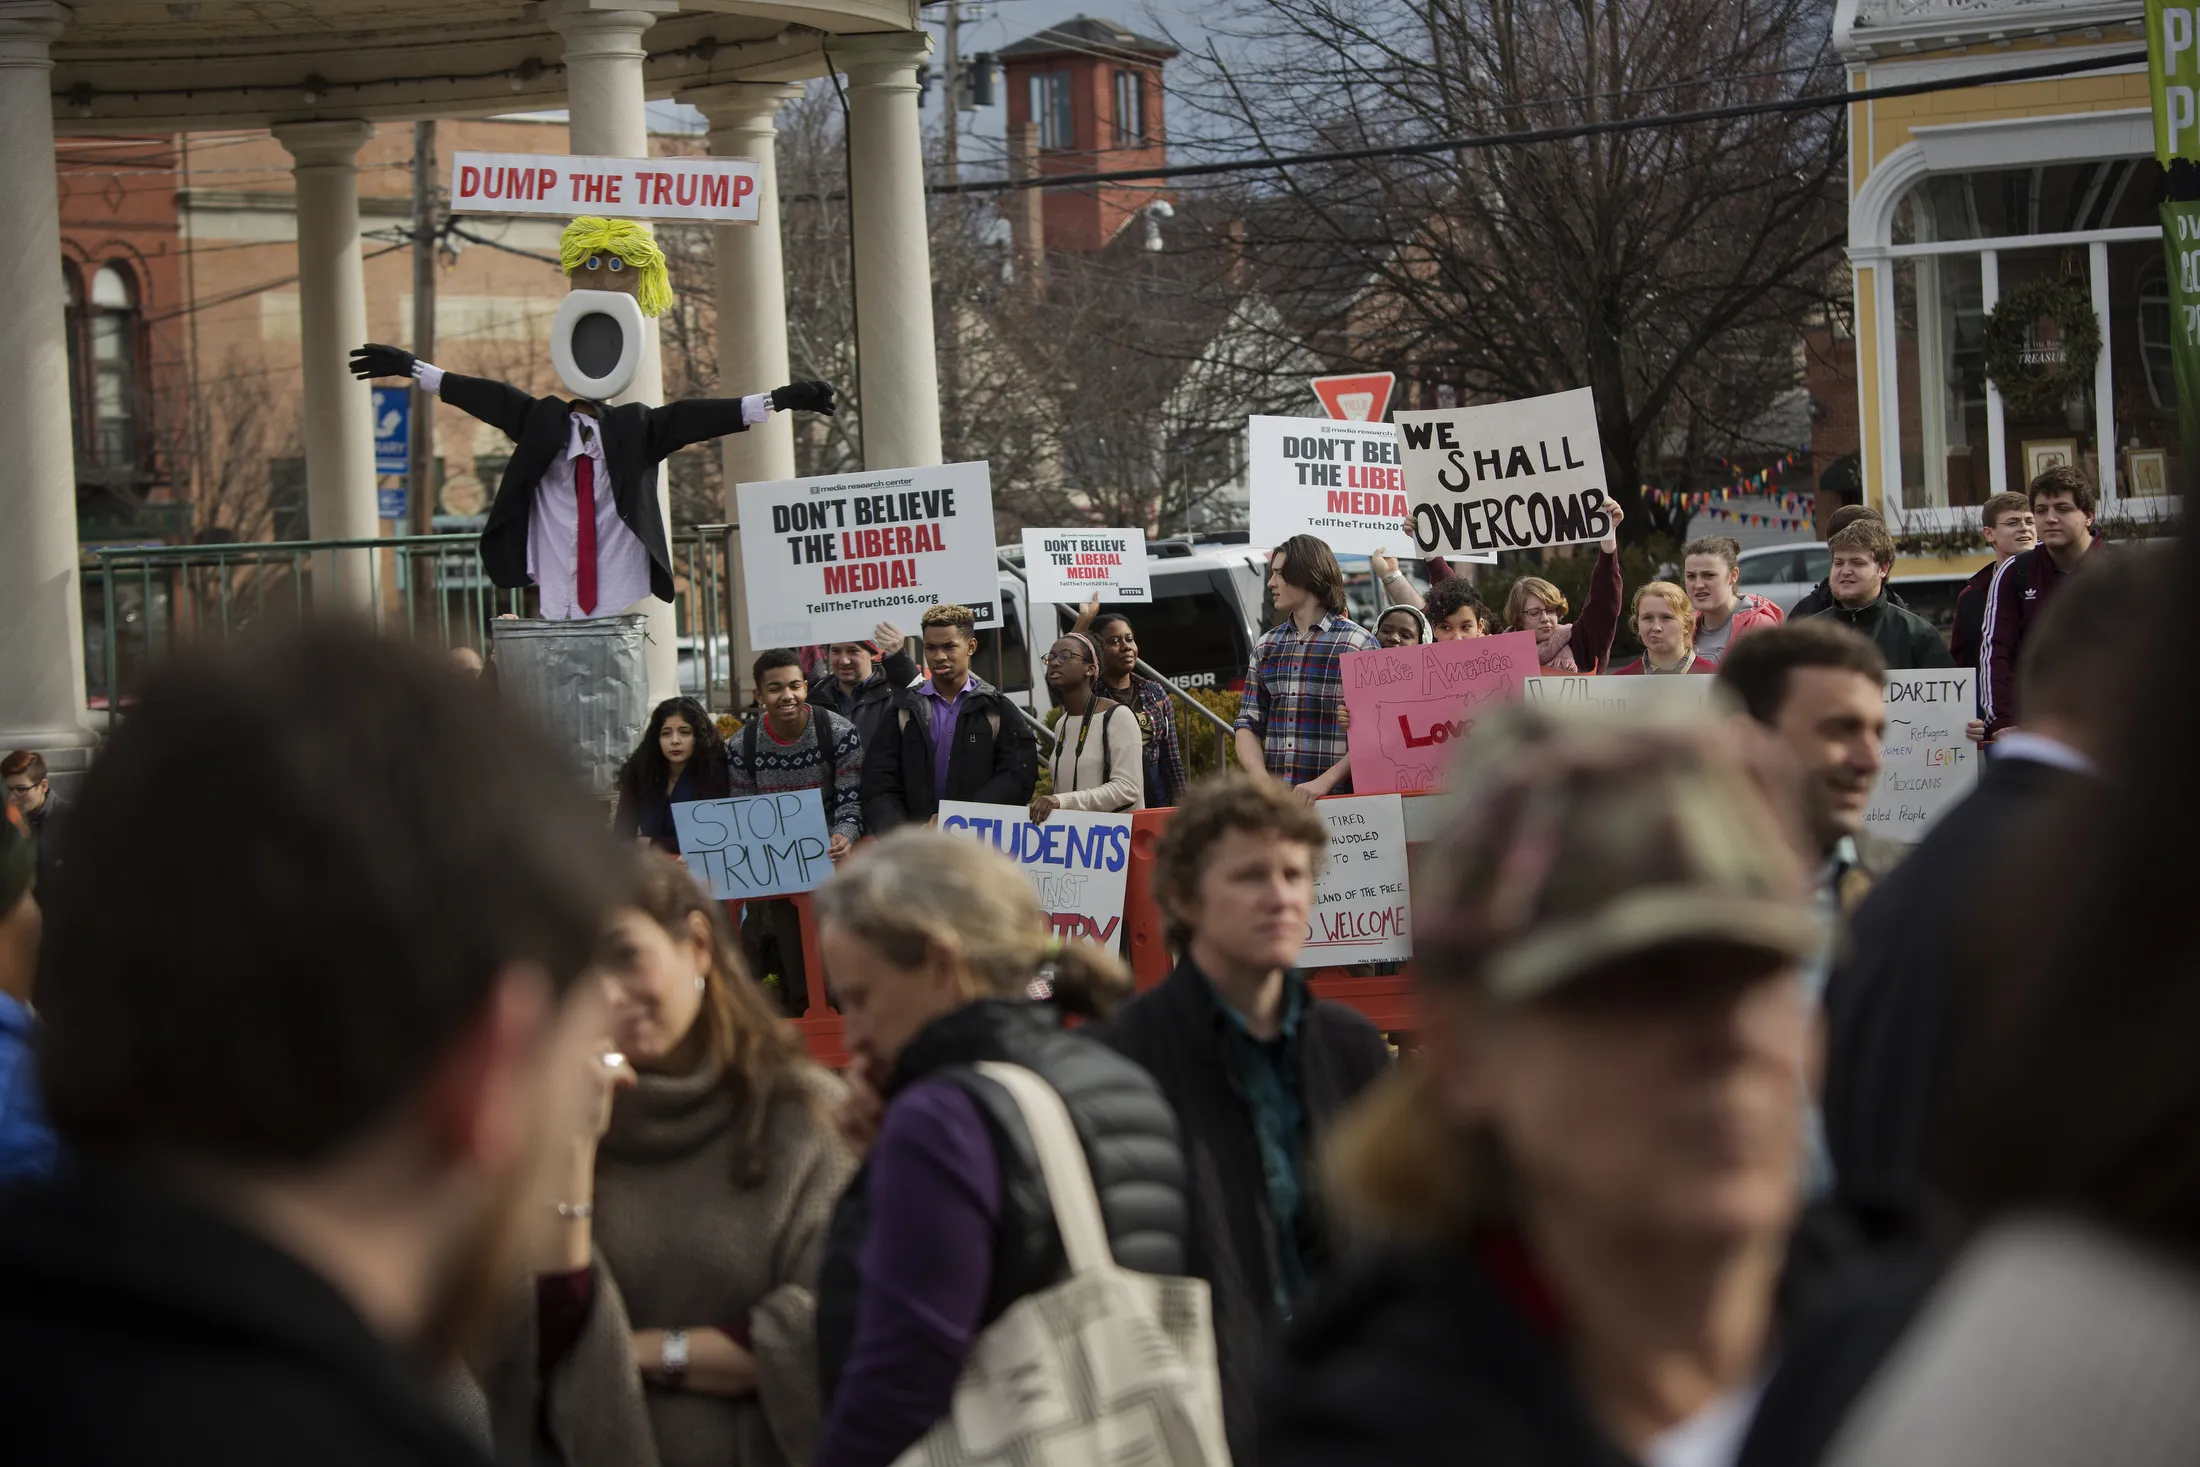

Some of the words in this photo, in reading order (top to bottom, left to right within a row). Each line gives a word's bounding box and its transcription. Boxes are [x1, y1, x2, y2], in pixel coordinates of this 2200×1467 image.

[460, 165, 557, 201] DUMP
[569, 173, 623, 203] THE
[635, 172, 754, 207] TRUMP
[1402, 422, 1459, 449] WE
[1283, 436, 1355, 461] DON'T
[1295, 462, 1342, 487] THE
[1438, 436, 1584, 493] SHALL
[847, 480, 884, 490] research
[885, 477, 912, 486] center
[772, 499, 847, 533] DON'T
[854, 488, 956, 525] BELIEVE
[1412, 488, 1610, 552] OVERCOMB
[787, 533, 837, 565] THE
[842, 523, 946, 560] LIBERAL
[1044, 540, 1077, 552] DON'T
[1081, 540, 1126, 552] BELIEVE
[1051, 553, 1073, 565] THE
[1075, 553, 1122, 565] LIBERAL
[823, 558, 918, 595] MEDIA!
[1067, 567, 1109, 579] MEDIA!
[806, 593, 939, 614] TellTheTruth2016.org
[973, 607, 989, 618] 16
[1883, 678, 1967, 704] DARITY
[1911, 725, 1949, 742] Refugees
[692, 794, 802, 846] STOP
[1898, 803, 1927, 823] People
[1331, 831, 1379, 845] HUDDLED
[687, 837, 826, 893] TRUMP
[1333, 853, 1349, 864] TO
[1362, 850, 1379, 861] BE
[1317, 893, 1342, 905] LAND
[1344, 889, 1357, 900] OF
[1359, 886, 1377, 898] THE
[1379, 882, 1406, 895] FREE.
[1319, 906, 1406, 941] WELCOME
